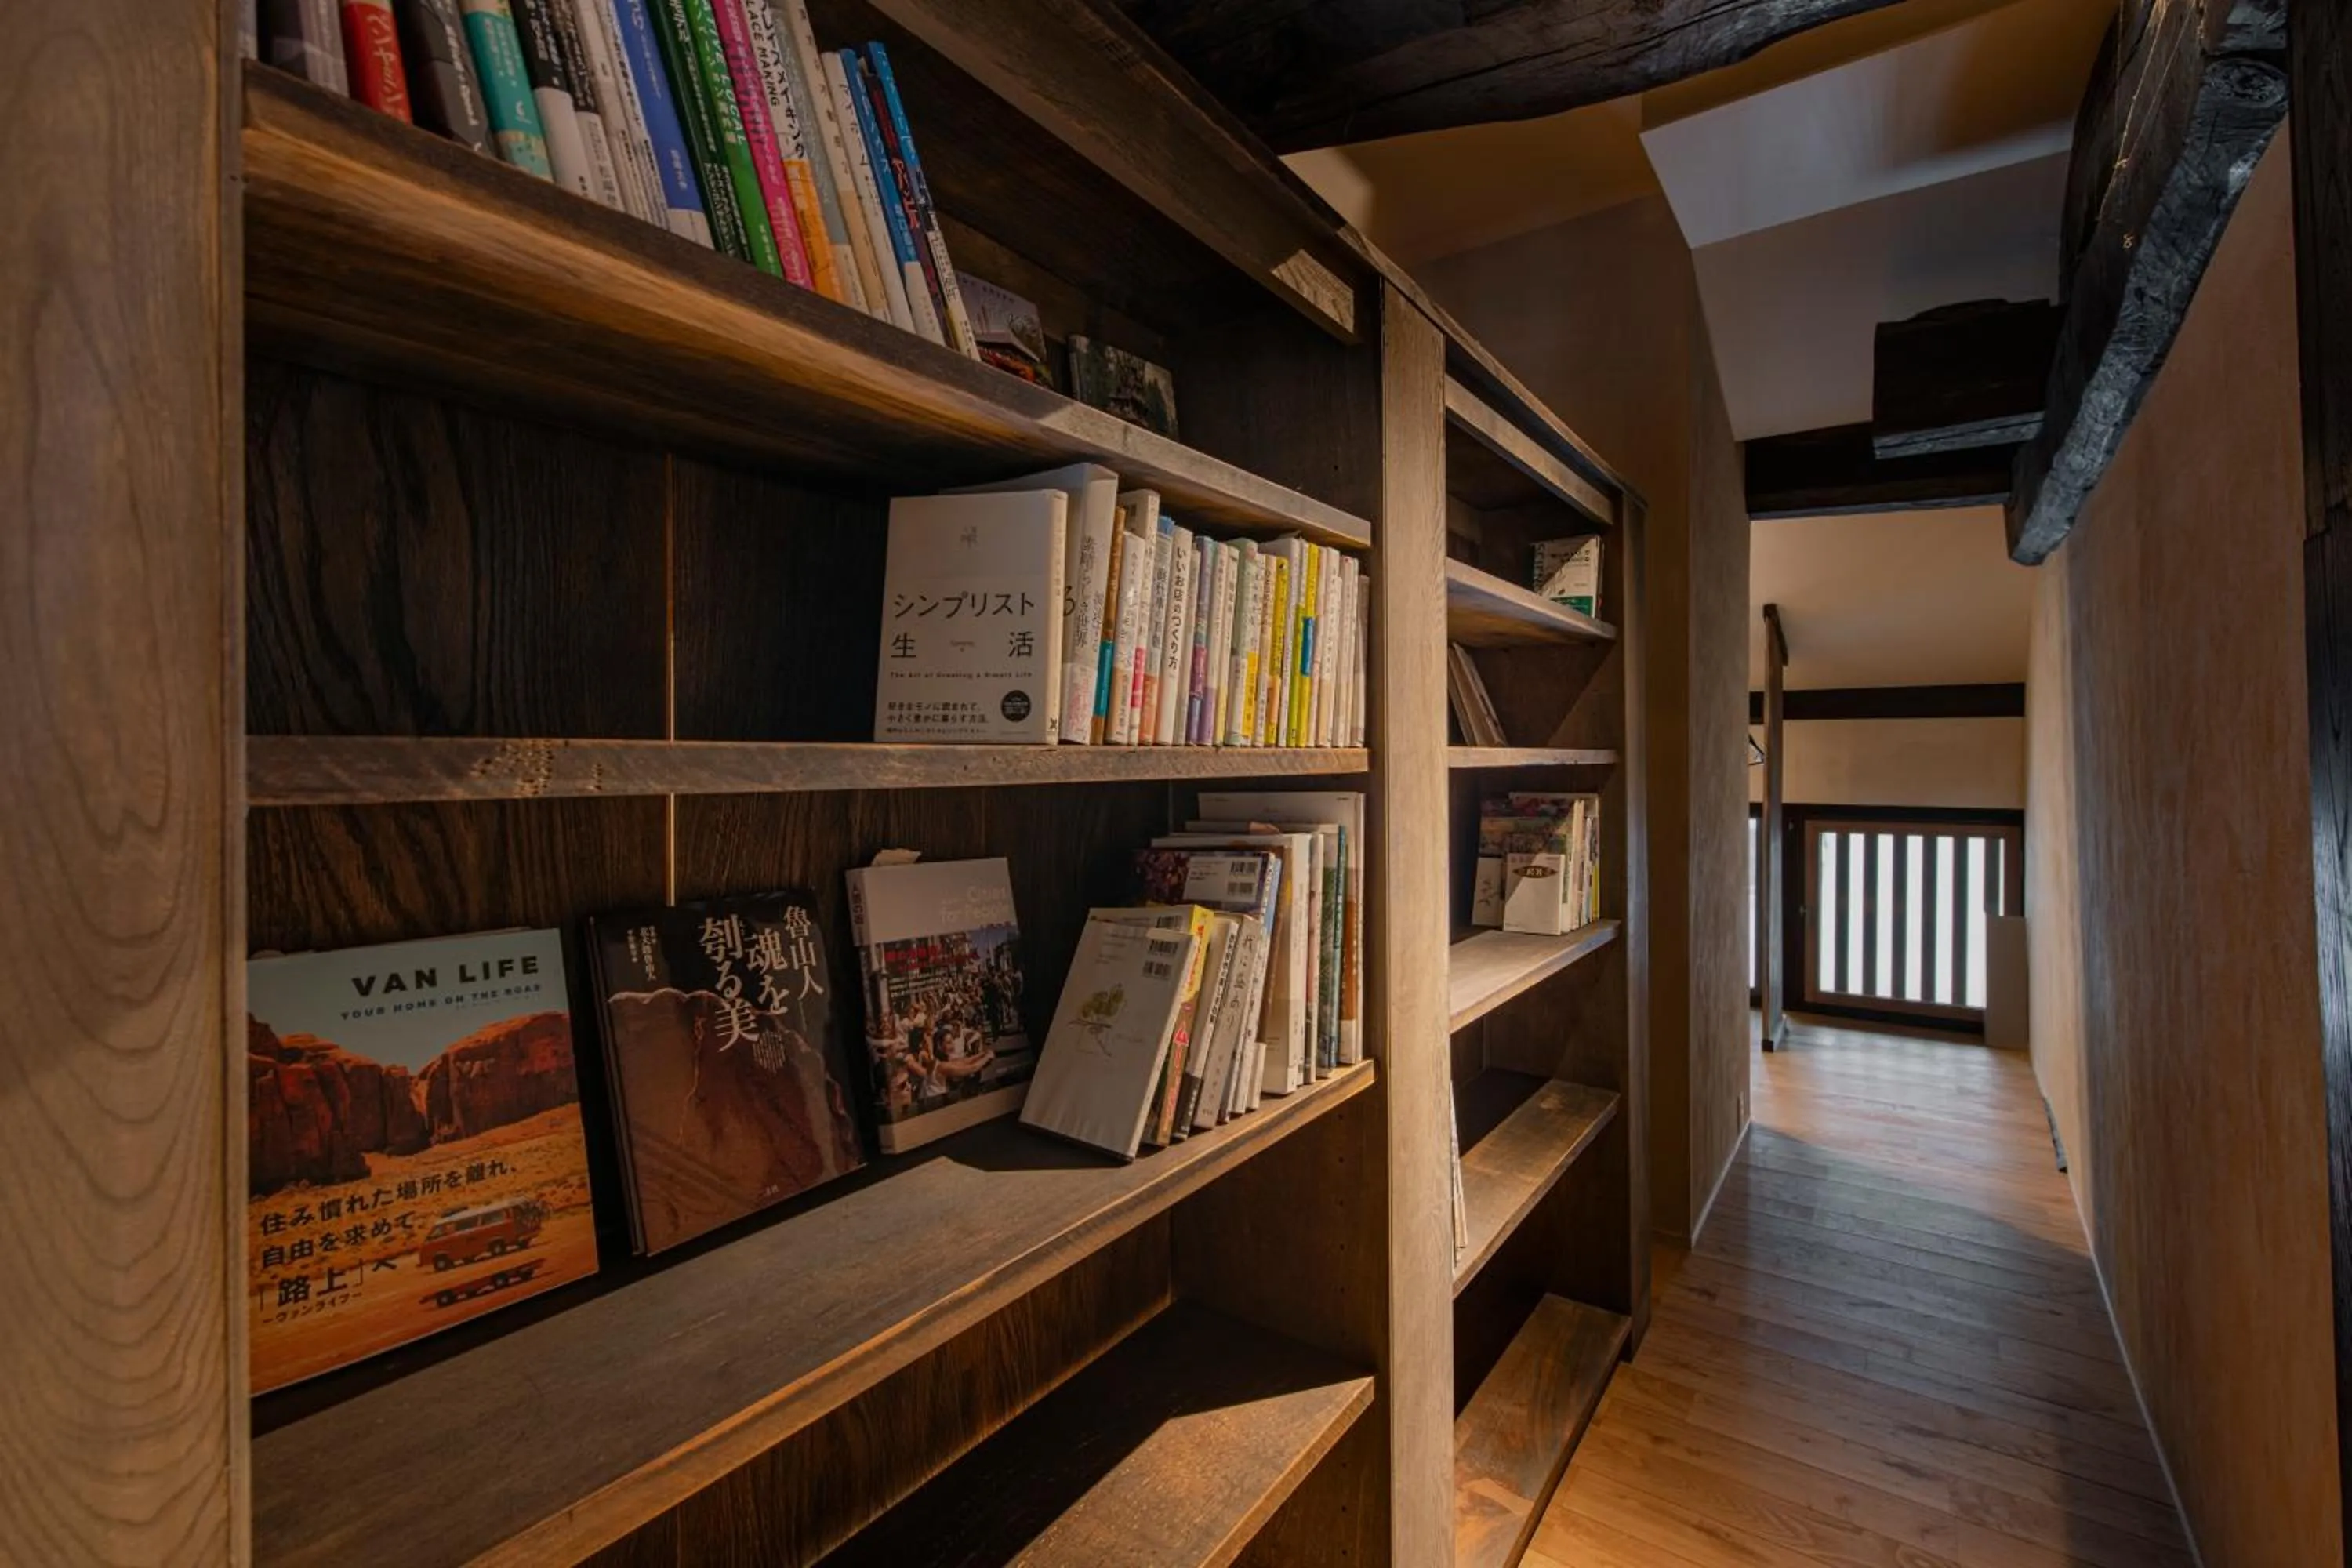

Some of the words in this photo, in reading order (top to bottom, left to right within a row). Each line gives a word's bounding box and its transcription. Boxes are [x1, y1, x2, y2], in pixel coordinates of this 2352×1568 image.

[757, 45, 780, 107] MAKING
[719, 74, 747, 147] LOCAL
[893, 590, 1035, 619] シンプリスト
[890, 632, 916, 659] 生
[1008, 630, 1035, 658] 活
[351, 967, 438, 997] VAN
[458, 956, 539, 984] LIFE
[744, 927, 790, 1015] 魂を
[784, 904, 825, 1001] 魯山人
[340, 1007, 386, 1021] YOUR
[393, 997, 437, 1013] HOME
[444, 995, 465, 1005] ON
[471, 989, 499, 1001] THE
[504, 984, 541, 996] ROAD
[260, 1160, 517, 1236] 住み慣れた場所を離れ、
